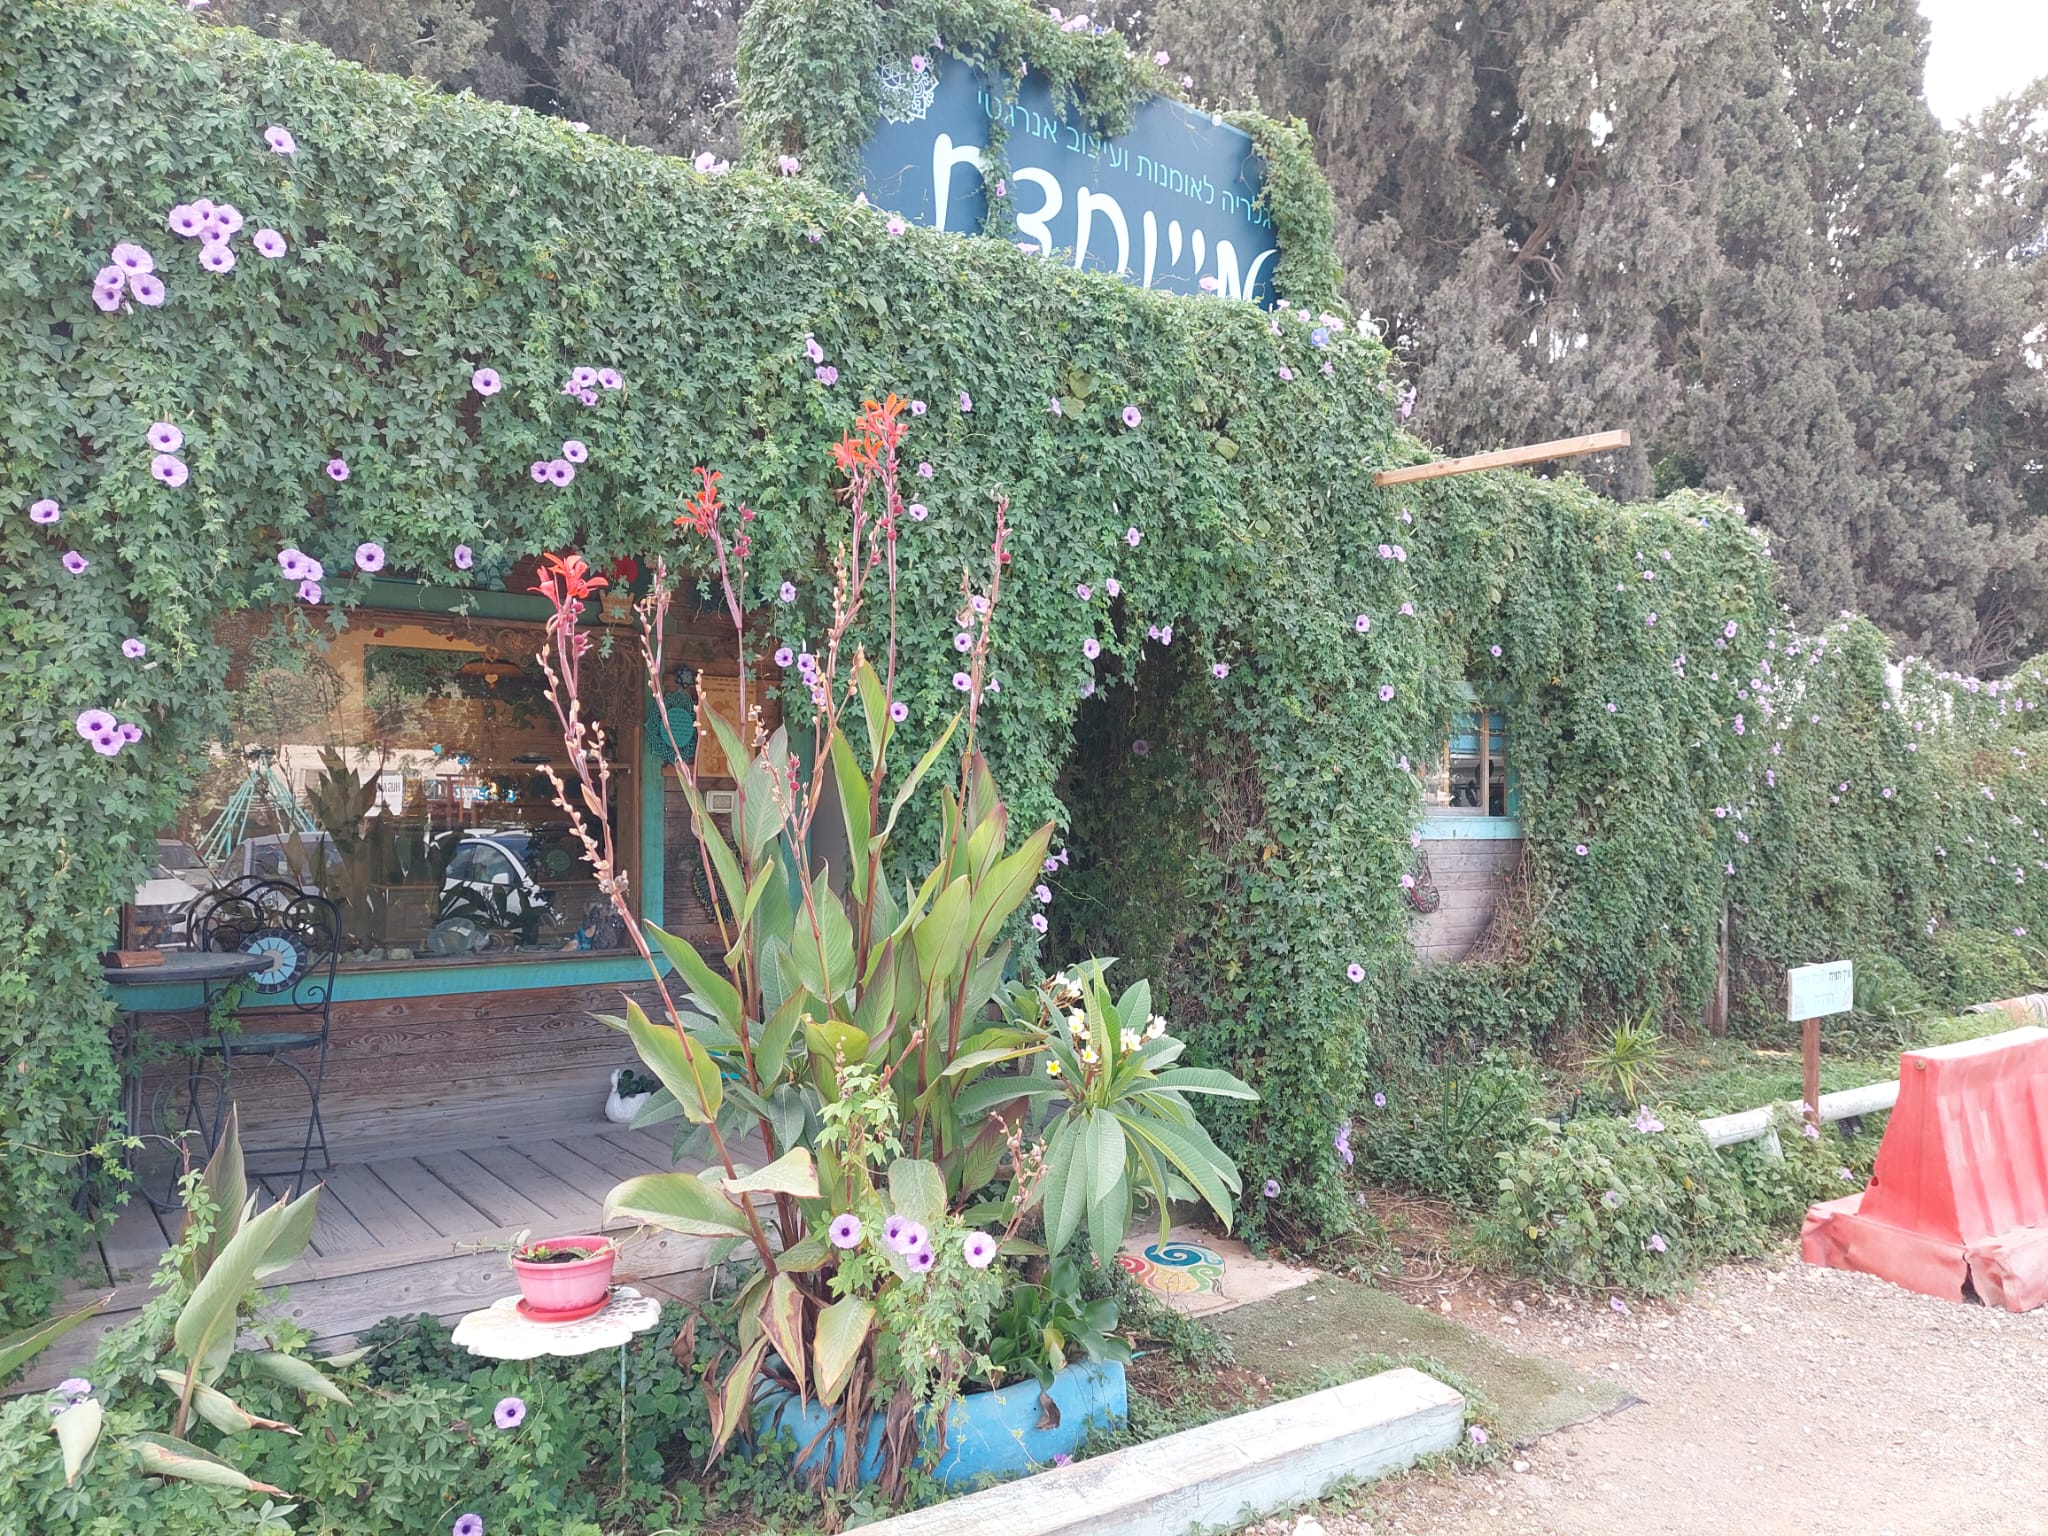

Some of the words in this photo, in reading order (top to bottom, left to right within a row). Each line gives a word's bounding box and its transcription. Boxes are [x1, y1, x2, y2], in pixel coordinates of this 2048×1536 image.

[977, 89, 1058, 144] אנרגטי
[1066, 125, 1129, 173] ועיצוב
[1136, 154, 1215, 205] לאומנות
[1222, 189, 1272, 230] גלריה
